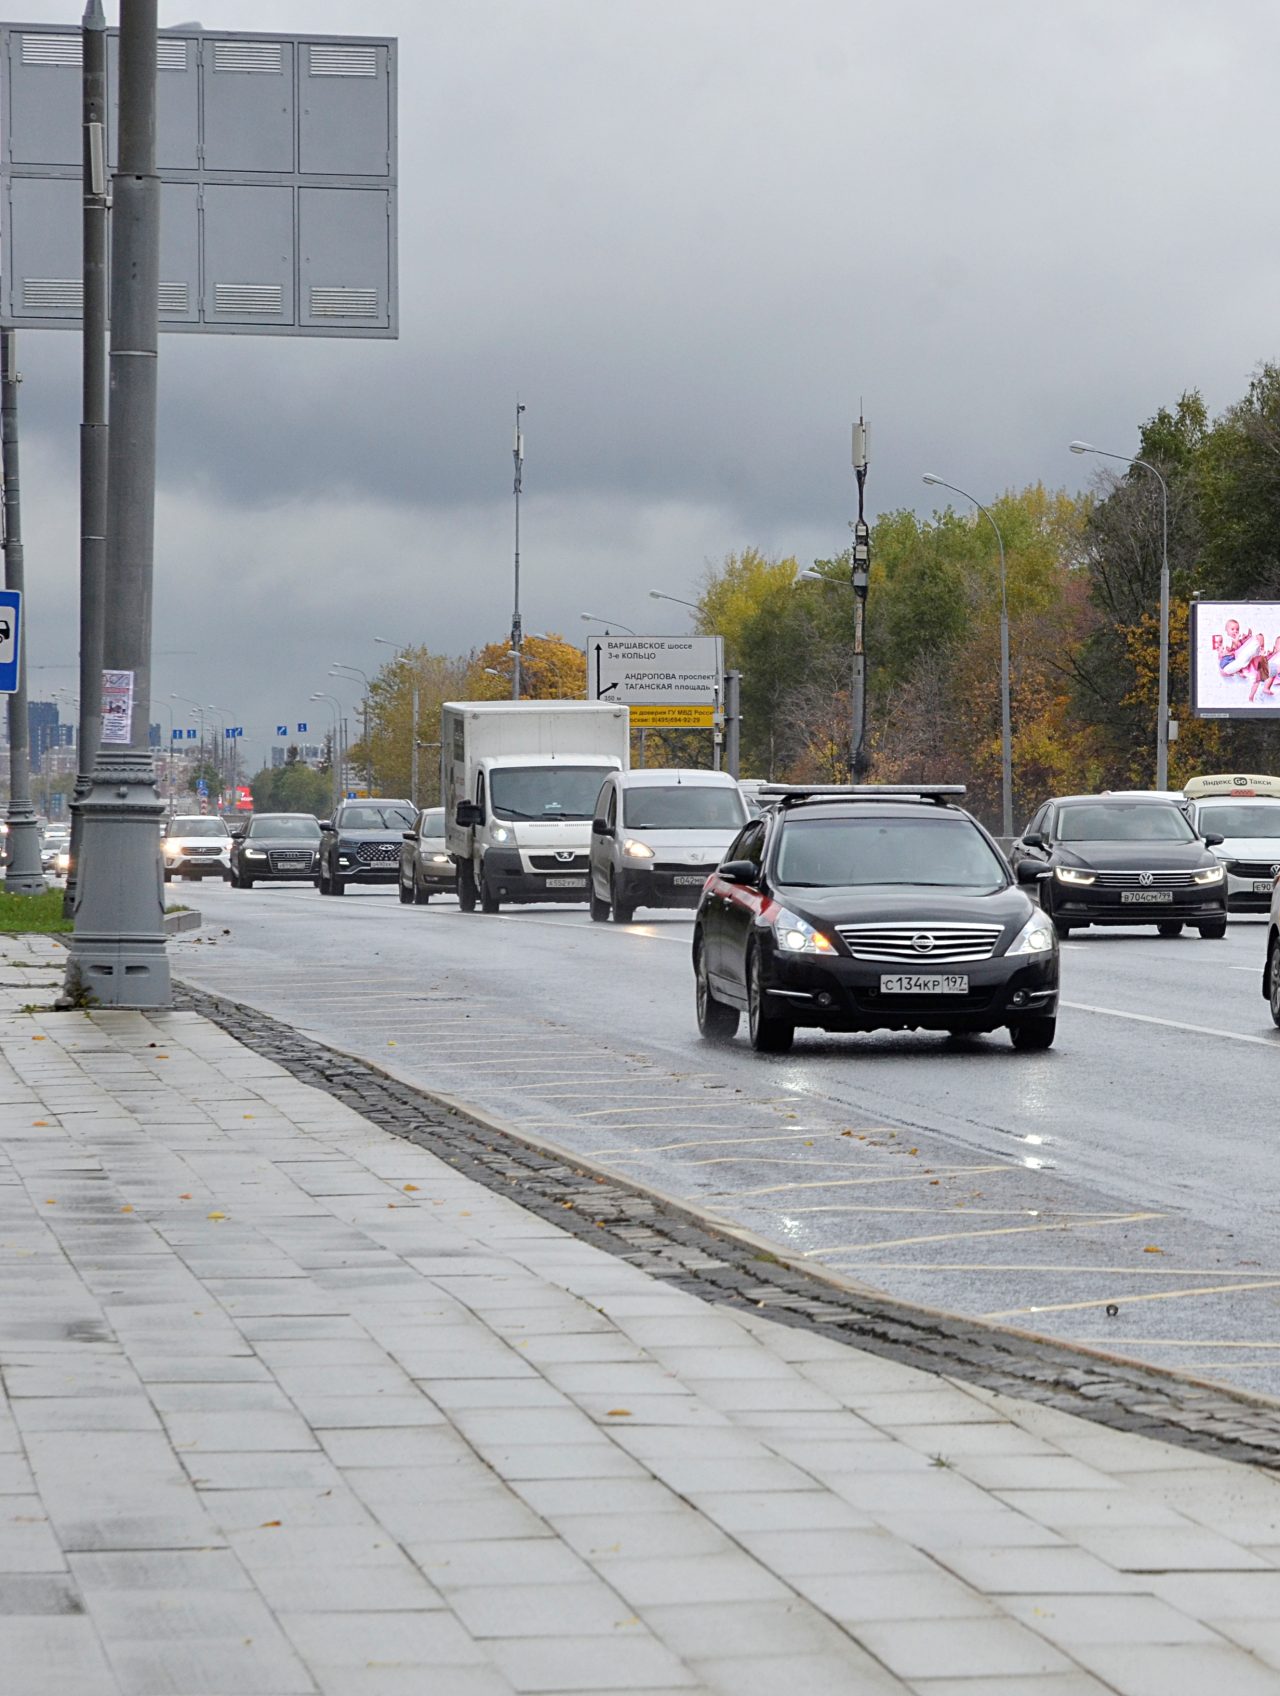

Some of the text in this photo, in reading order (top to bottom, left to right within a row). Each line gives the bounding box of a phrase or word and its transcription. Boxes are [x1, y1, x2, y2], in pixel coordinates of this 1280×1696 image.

[607, 642, 665, 650] ВАРШАВСКОЕ
[621, 652, 657, 660] КОЛЬЦО
[624, 673, 677, 681] АНДРОПОВА
[1202, 779, 1232, 787] Яндекс
[1123, 892, 1157, 902] В704СМ
[884, 976, 964, 991] С134КР 197
